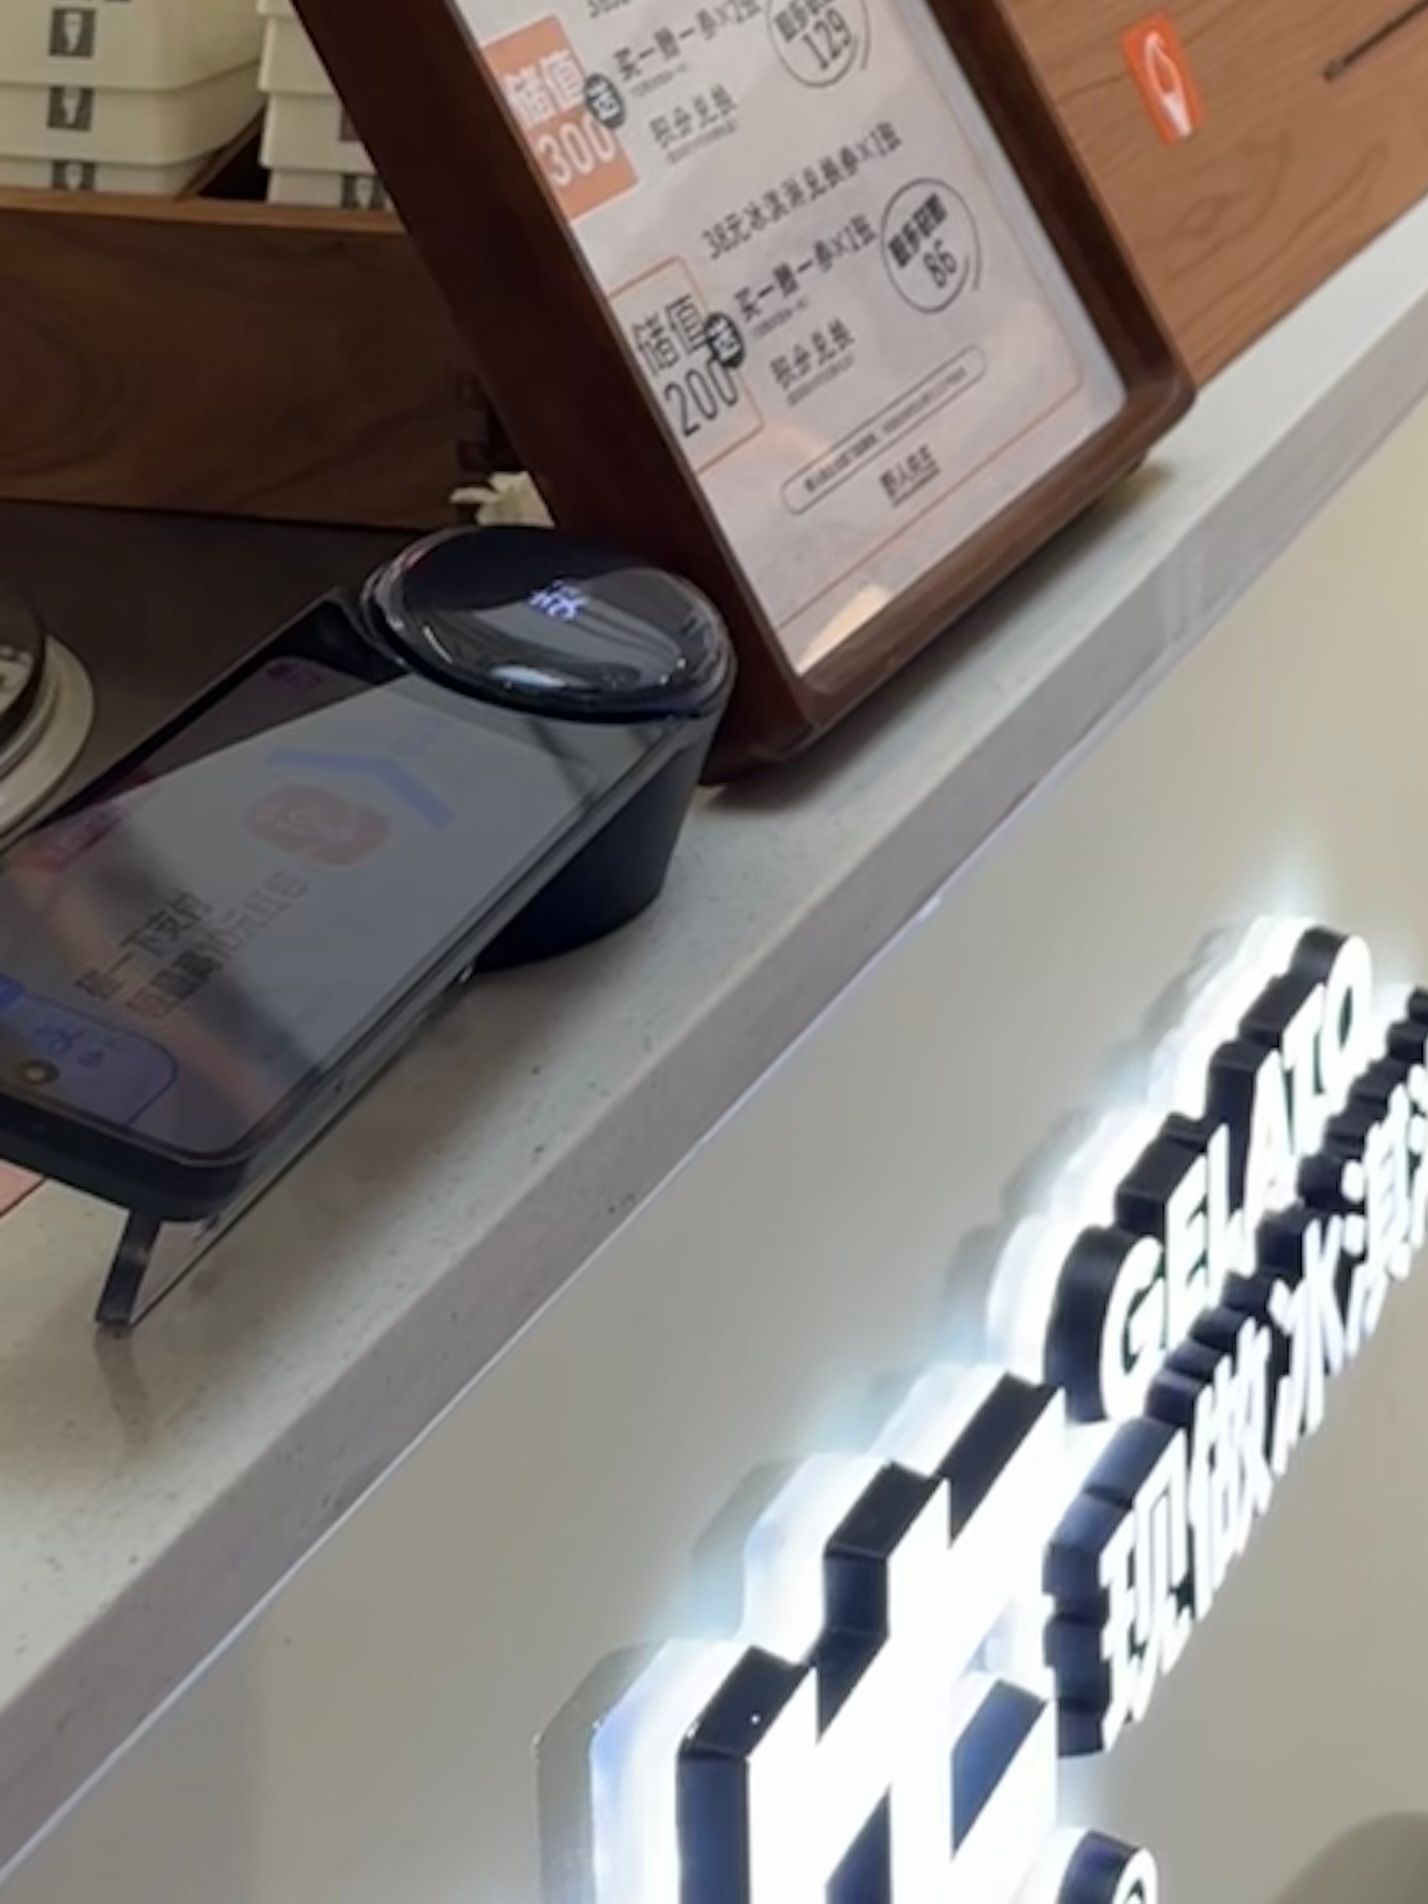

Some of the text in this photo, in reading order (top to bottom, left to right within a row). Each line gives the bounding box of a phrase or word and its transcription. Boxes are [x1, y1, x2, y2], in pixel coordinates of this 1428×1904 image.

[803, 8, 852, 72] 129
[538, 114, 616, 188] 300
[923, 239, 958, 290] 86
[631, 293, 706, 378] 储值
[665, 357, 739, 437] 200
[1100, 935, 1372, 1422] GELATO
